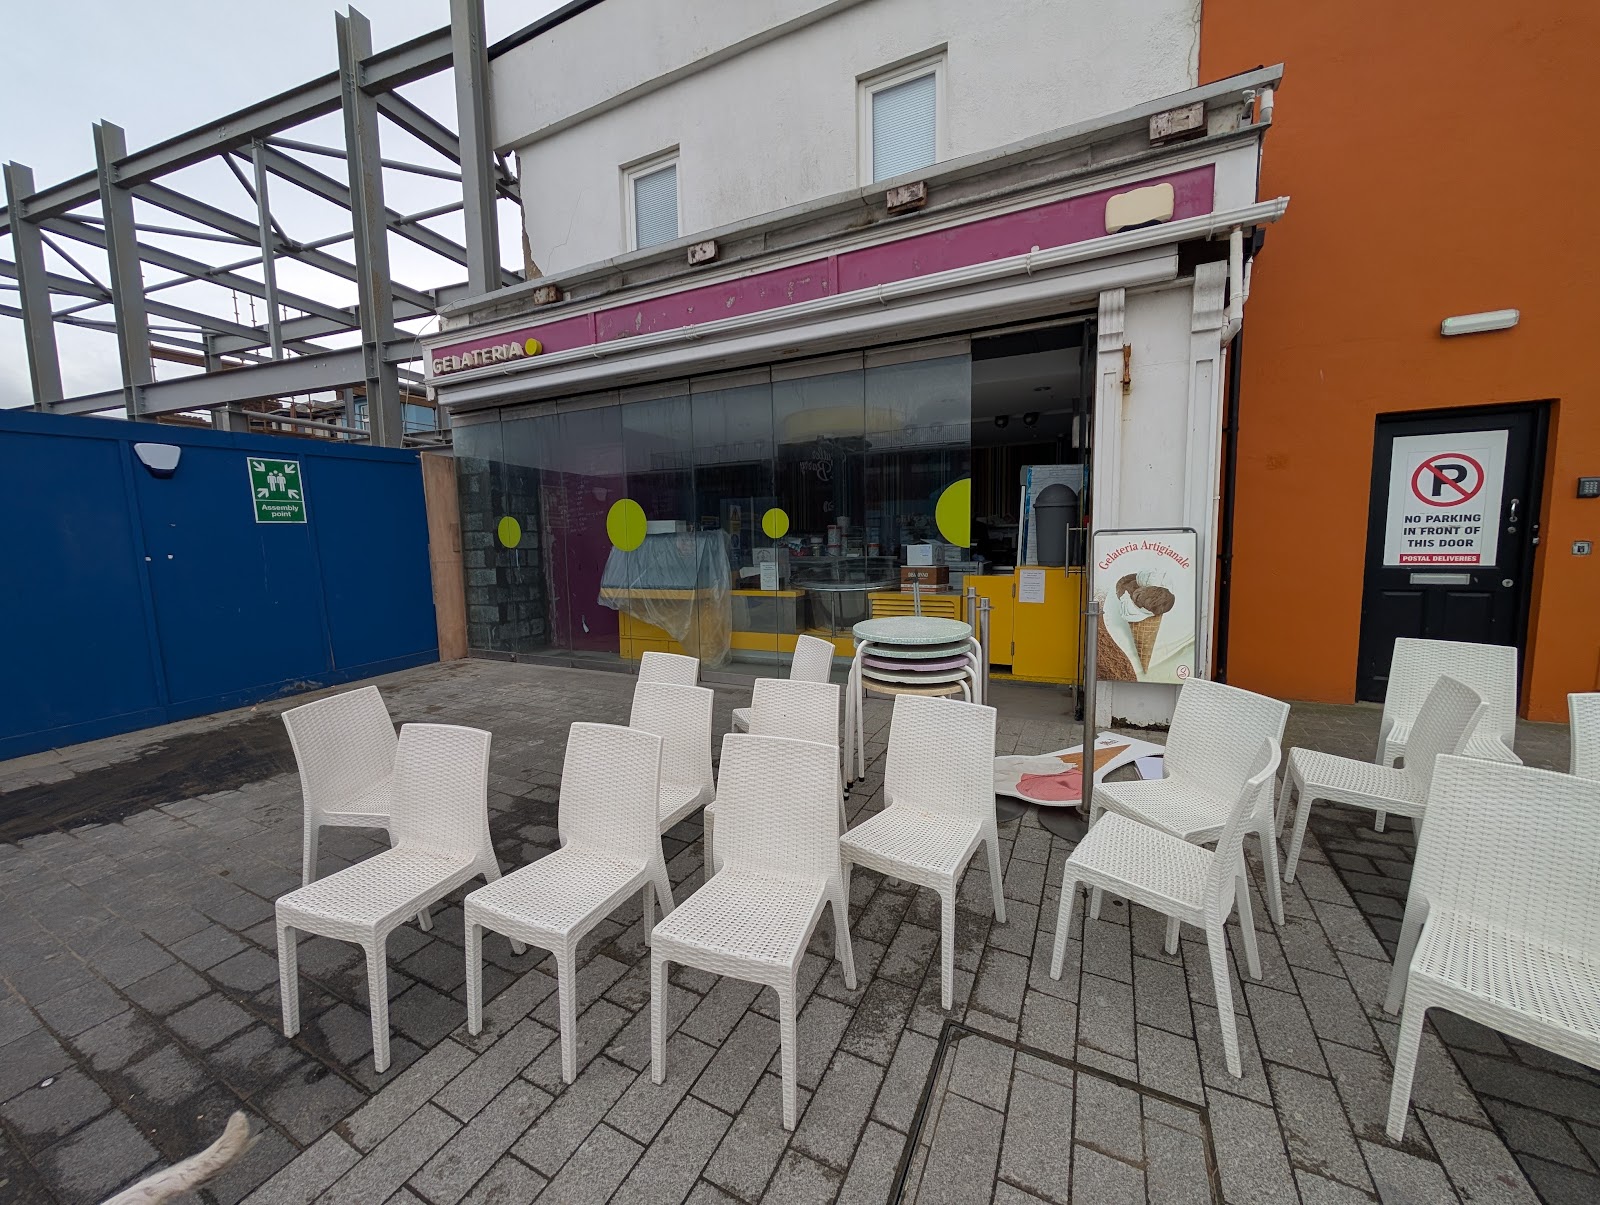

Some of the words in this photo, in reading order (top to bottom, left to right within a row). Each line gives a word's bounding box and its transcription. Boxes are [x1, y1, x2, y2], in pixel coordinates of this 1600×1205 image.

[433, 341, 524, 374] GELATERIA
[261, 504, 299, 512] Assembly
[1404, 515, 1422, 523] NO
[1425, 513, 1481, 523] PARKING
[1403, 527, 1416, 535] IN
[1420, 526, 1461, 535] FRONT
[1464, 526, 1481, 535] OF
[1407, 539, 1435, 547] THIS
[1438, 539, 1474, 547] DOOR
[1098, 541, 1138, 570] Gelateria
[1140, 539, 1190, 570] Artigianale
